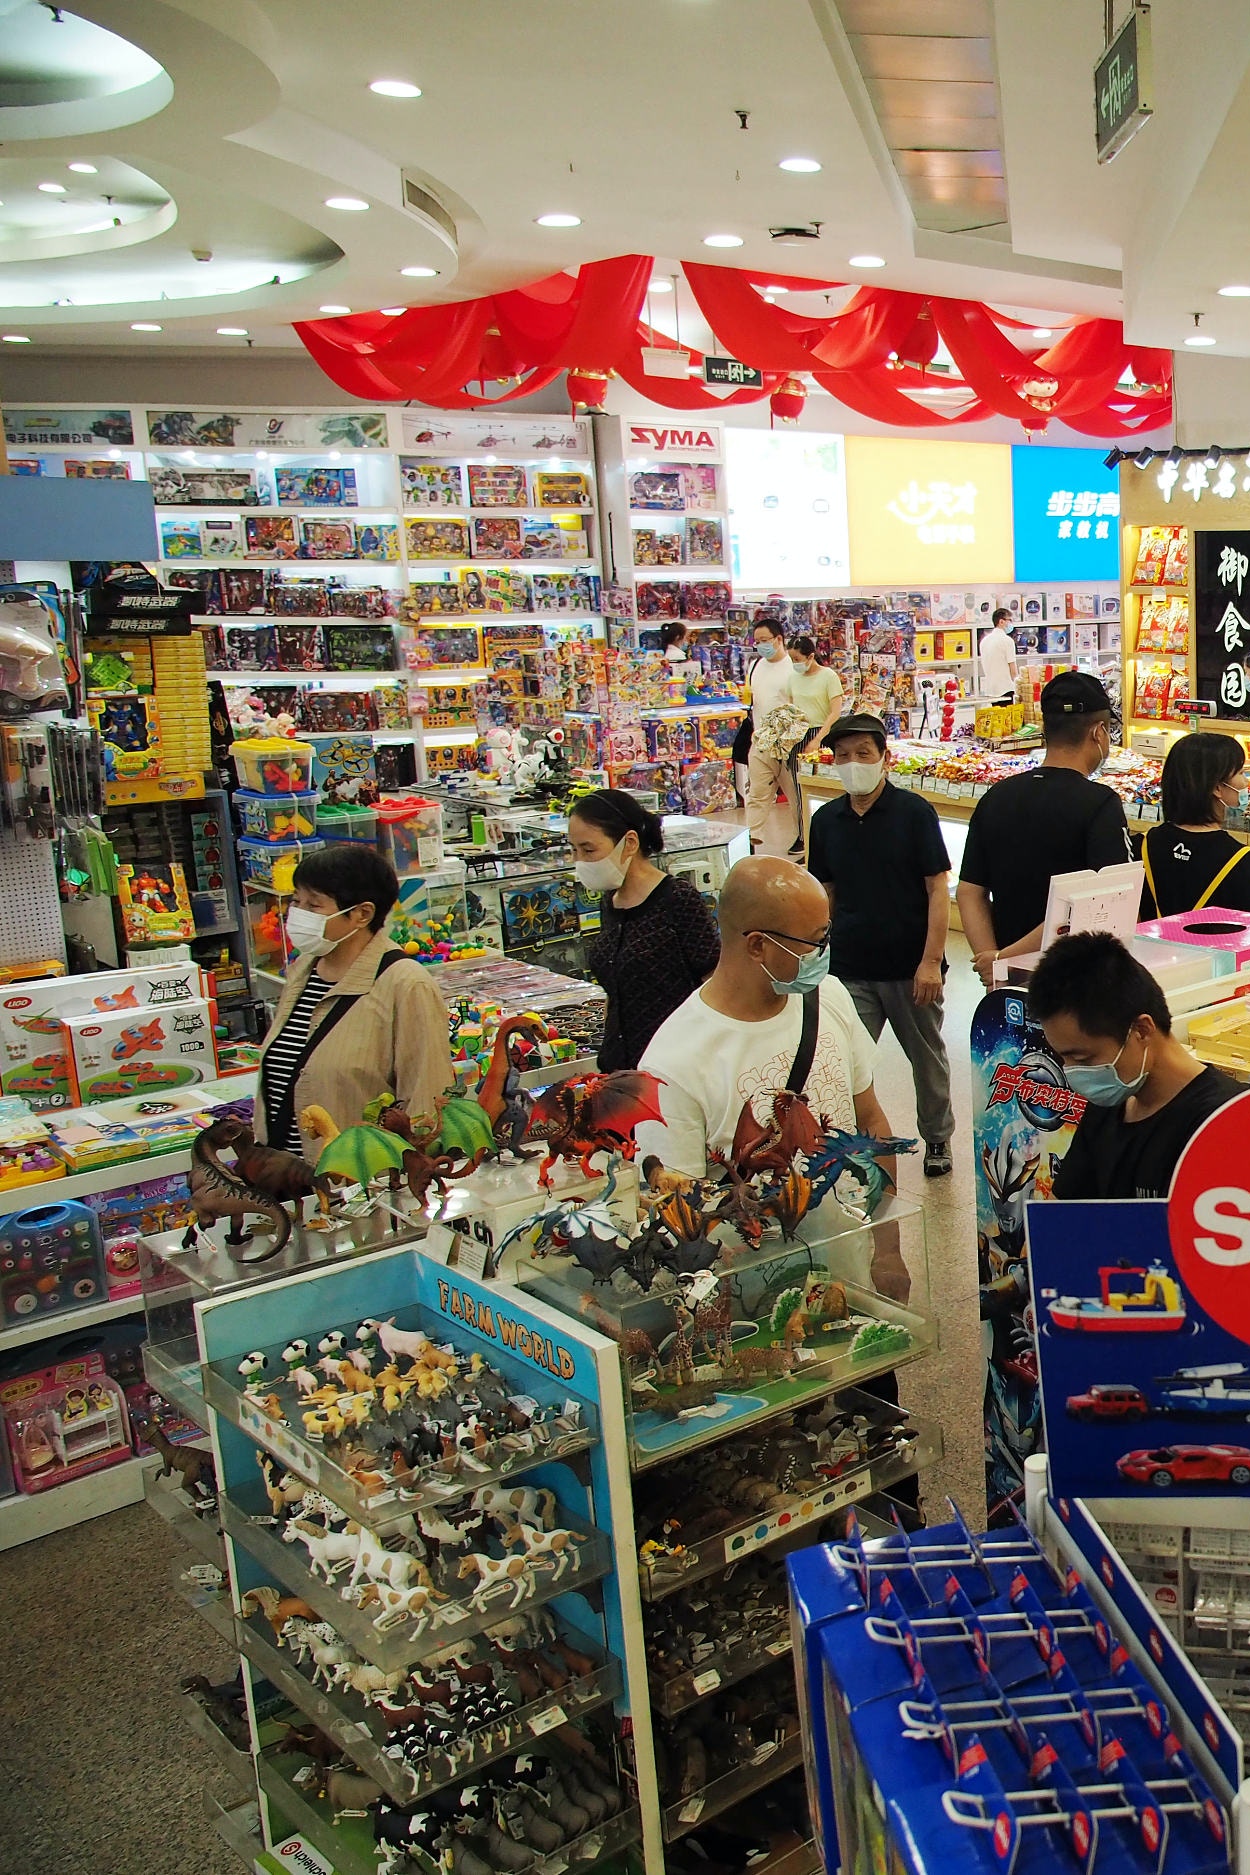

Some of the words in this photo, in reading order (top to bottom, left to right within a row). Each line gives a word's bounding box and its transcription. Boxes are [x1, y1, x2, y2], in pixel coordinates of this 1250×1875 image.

[630, 427, 715, 451] SYMA
[437, 1278, 497, 1339] FARM
[496, 1311, 576, 1381] WORLD
[293, 1849, 328, 1875] chleich
